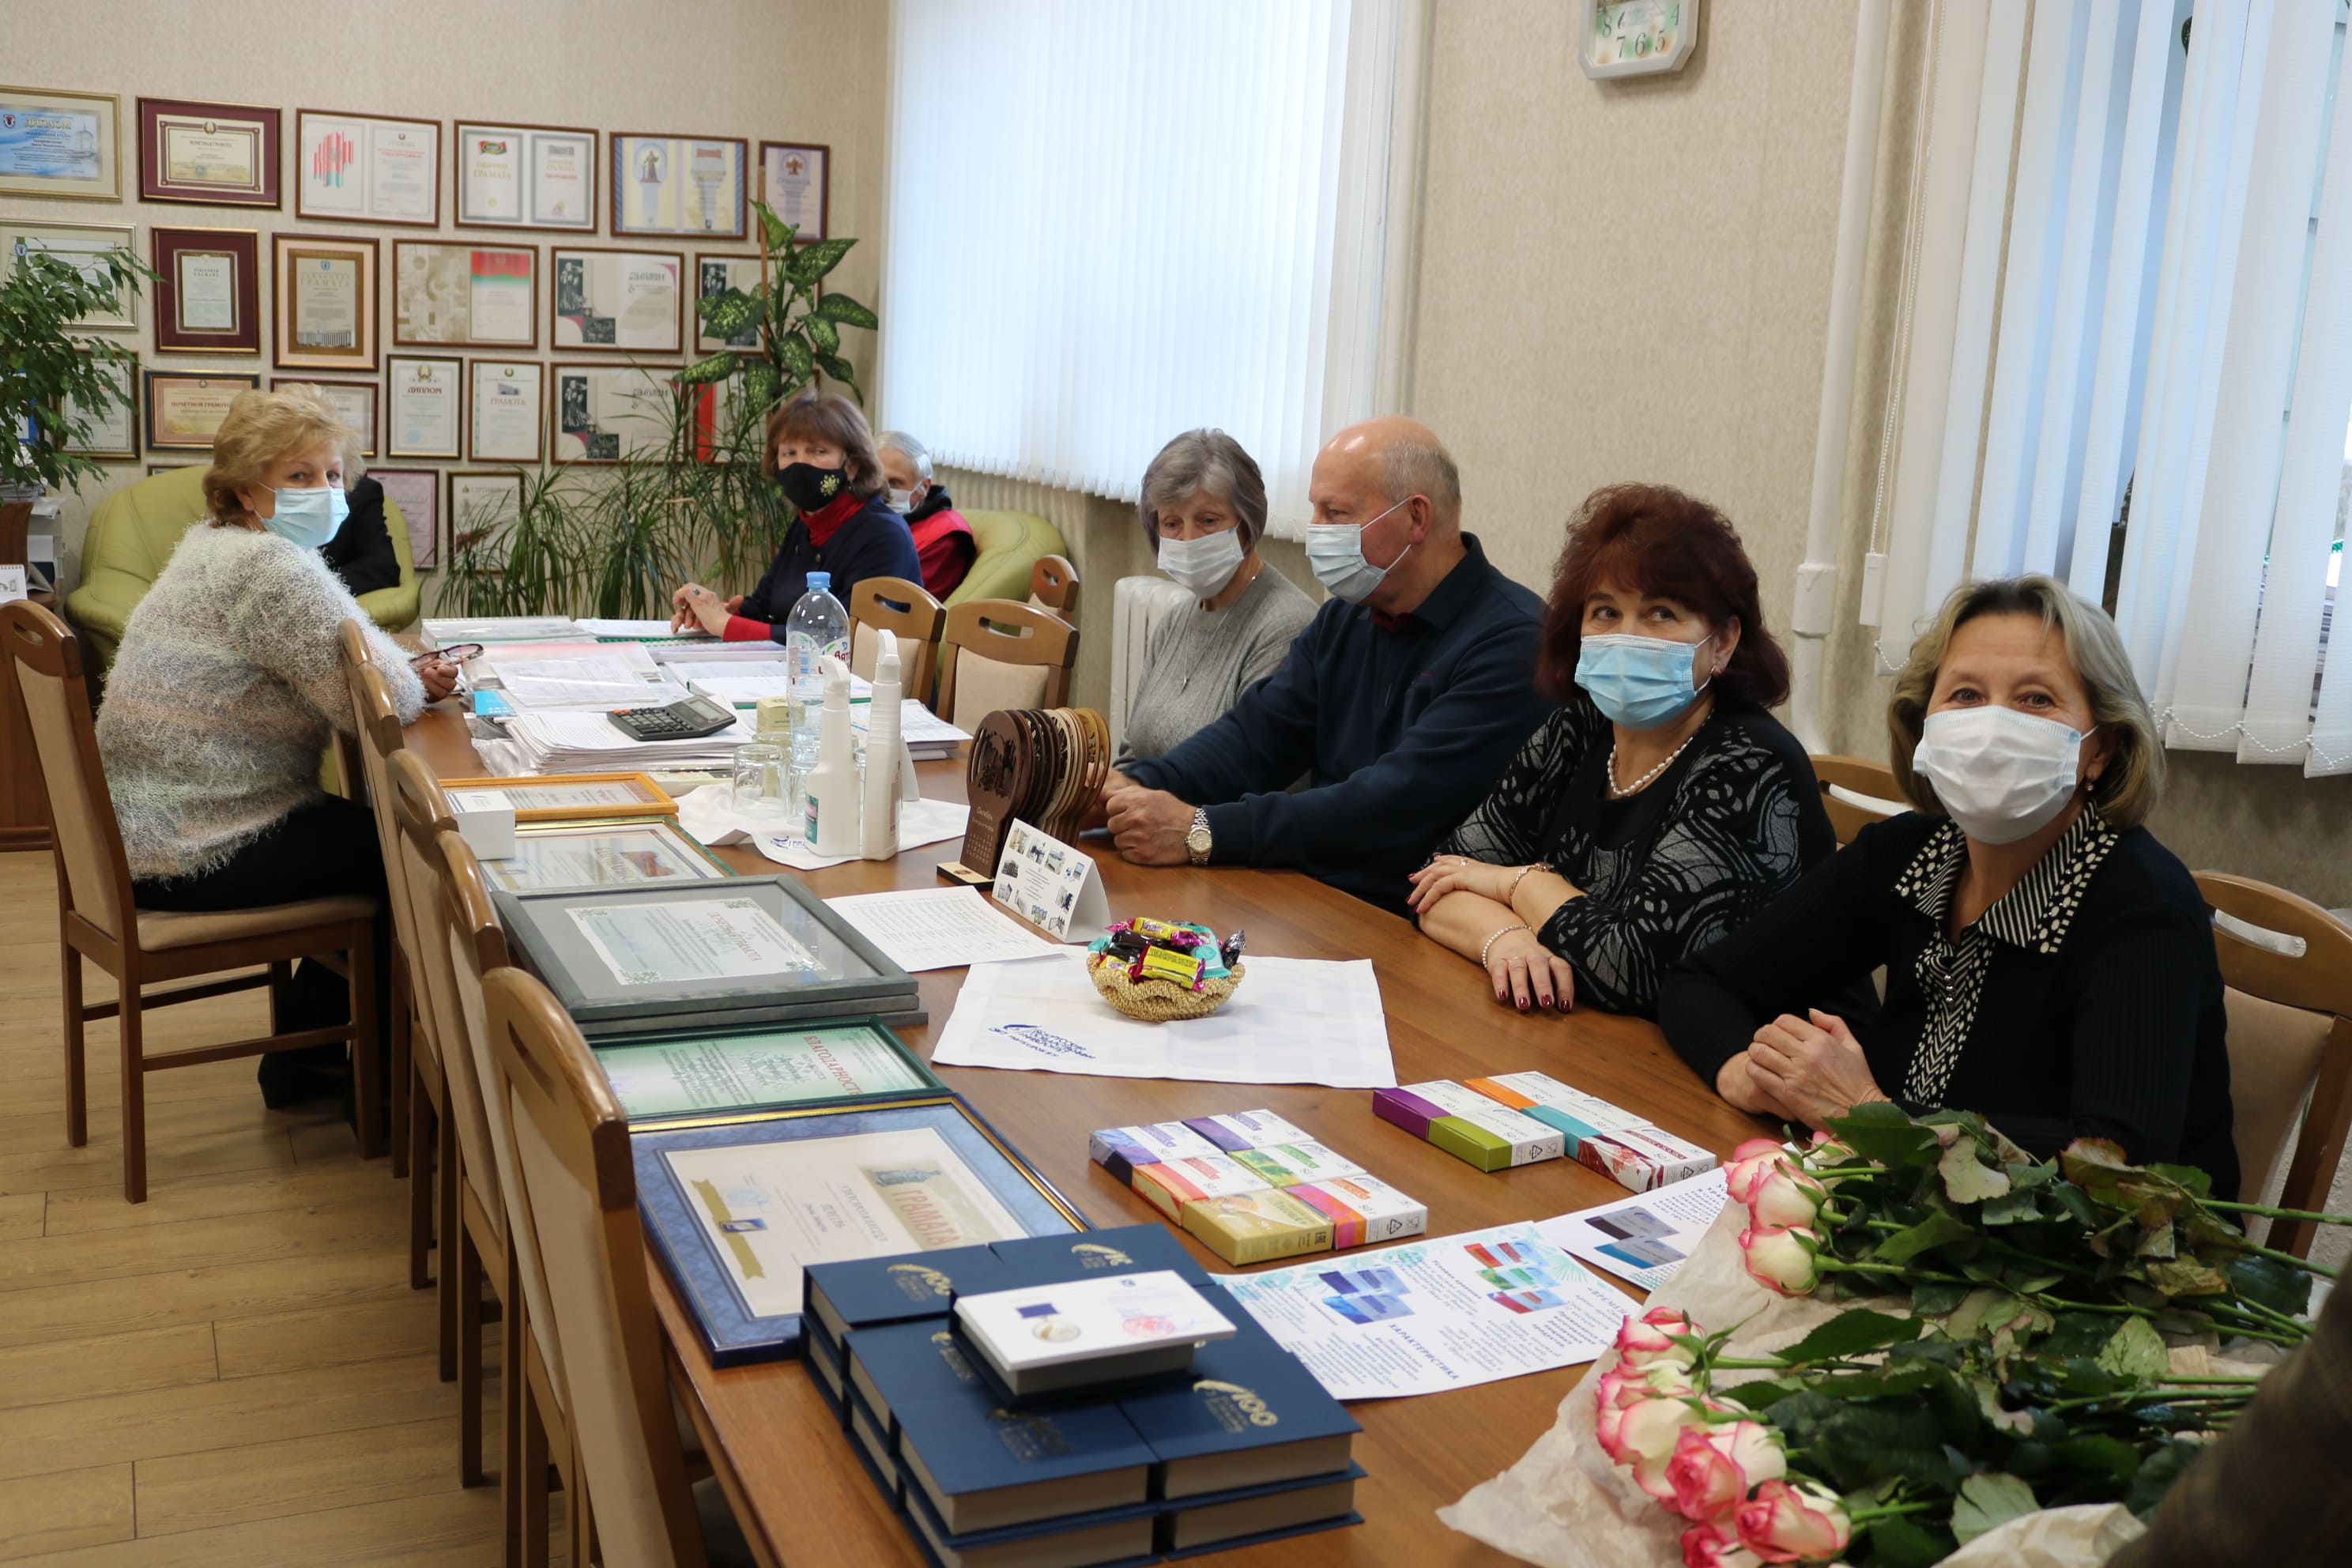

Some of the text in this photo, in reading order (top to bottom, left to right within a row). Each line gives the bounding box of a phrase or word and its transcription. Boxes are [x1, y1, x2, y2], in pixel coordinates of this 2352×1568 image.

[1671, 4, 1679, 25] 4
[1602, 15, 1612, 38] 8
[1616, 36, 1625, 58] 7
[1635, 32, 1645, 55] 6
[1655, 28, 1665, 52] 5
[891, 1189, 962, 1246] ГРАМАТА
[1389, 1322, 1459, 1380] ХАРАКТЕРИСТИКА
